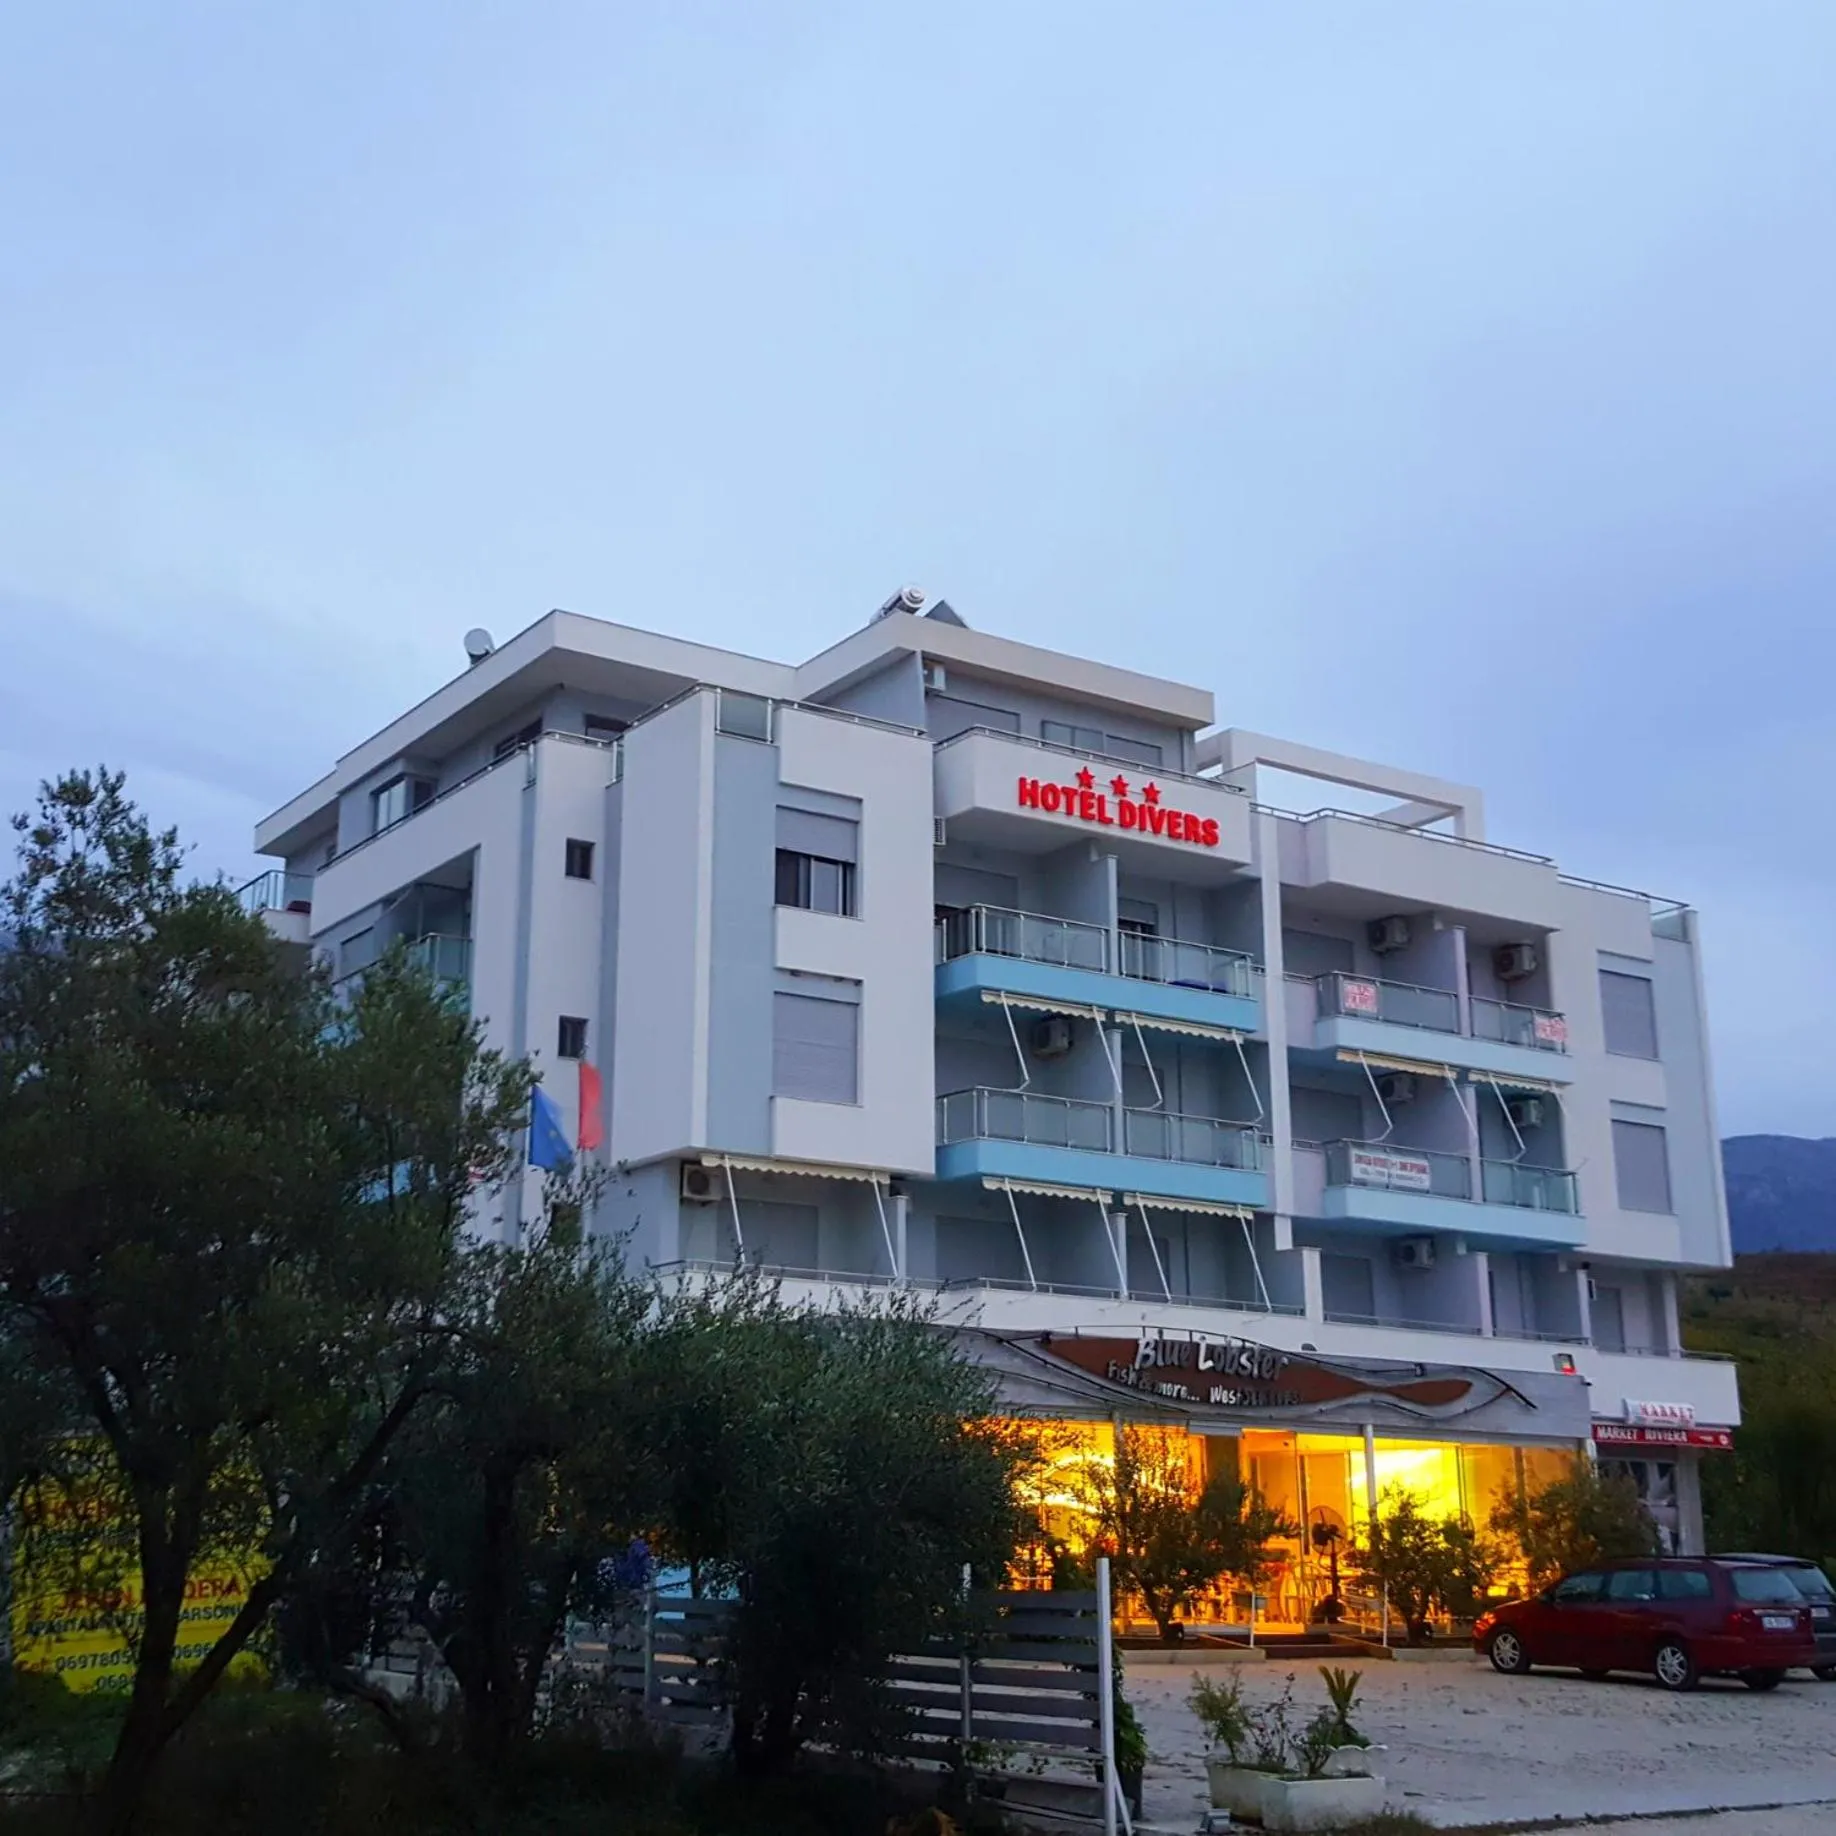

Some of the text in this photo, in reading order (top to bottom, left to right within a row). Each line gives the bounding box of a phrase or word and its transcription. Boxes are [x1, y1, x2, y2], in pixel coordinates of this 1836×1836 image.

[1018, 777, 1219, 847] HOTEL DIVERS
[1107, 1359, 1137, 1386] Fish
[1135, 1335, 1288, 1381] Blue Lobster
[1595, 1425, 1638, 1441] MARKET
